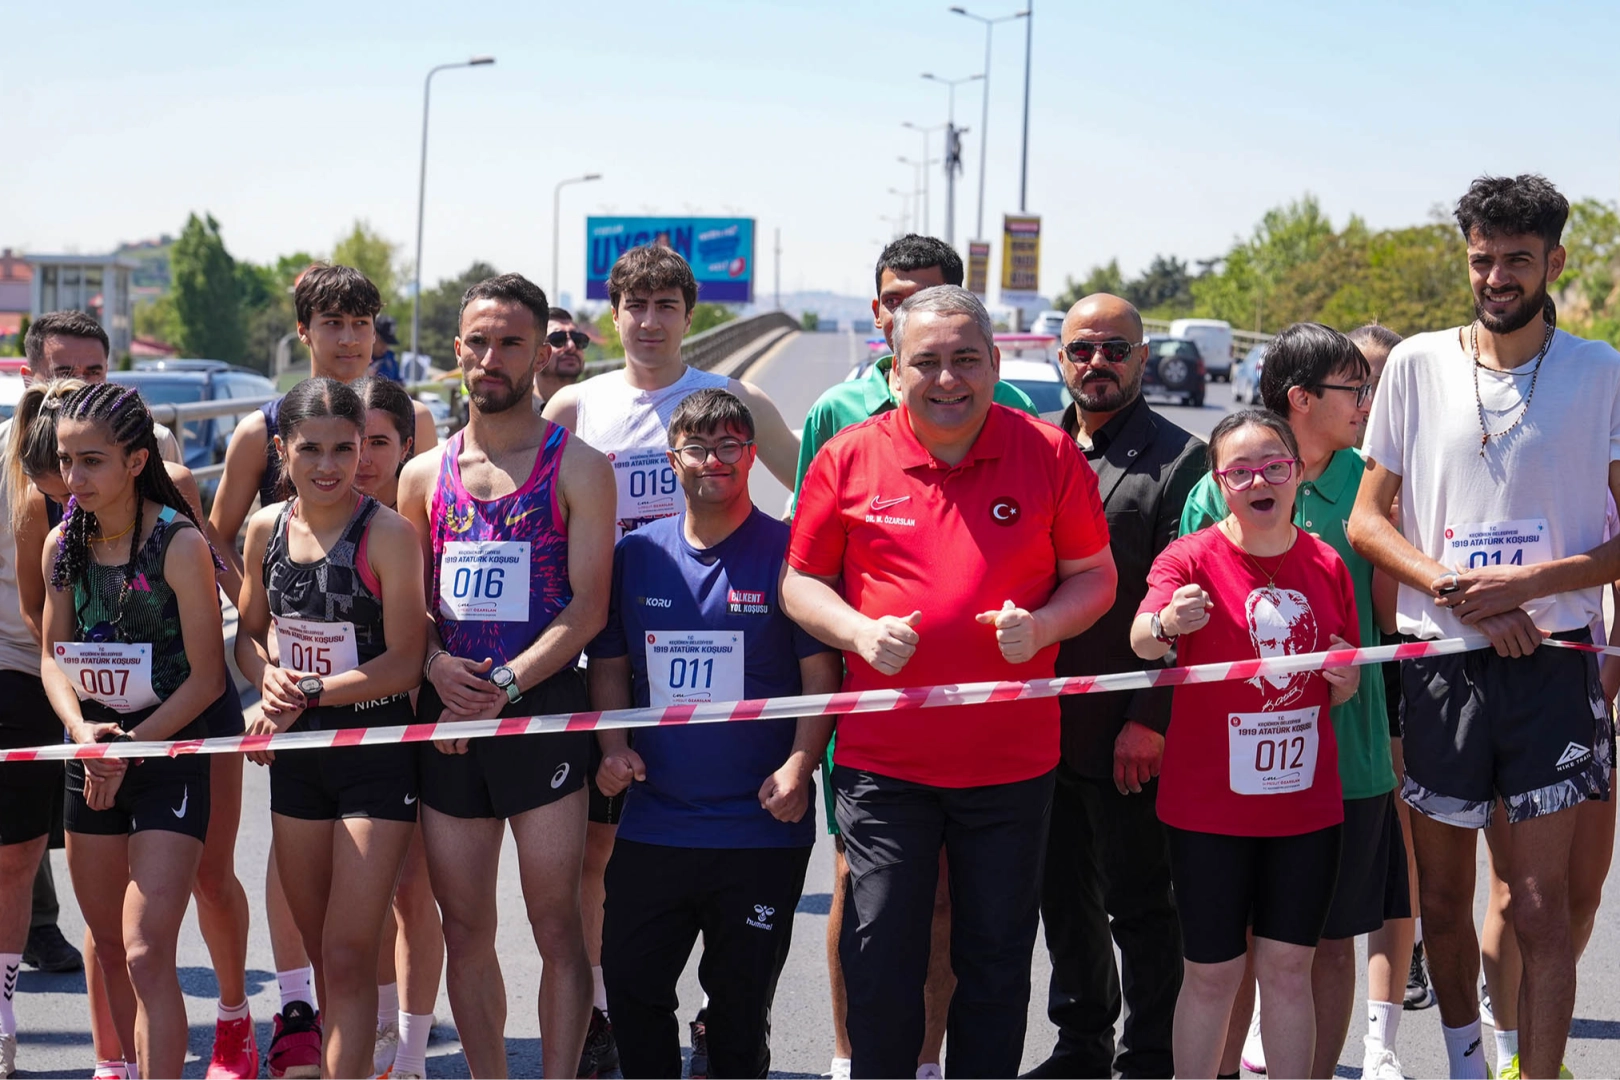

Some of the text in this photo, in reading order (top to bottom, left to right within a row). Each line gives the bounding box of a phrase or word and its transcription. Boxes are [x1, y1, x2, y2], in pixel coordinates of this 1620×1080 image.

[594, 226, 692, 275] UYN
[630, 458, 659, 467] ATATÜRK
[630, 467, 676, 498] 019
[884, 514, 916, 526] ÖZARSLAN
[1452, 535, 1540, 548] 1919 ATATÜRK KOŞUSU
[488, 556, 520, 564] KOŞUSU
[453, 568, 505, 598] 016
[646, 597, 672, 608] KORU
[731, 591, 762, 604] BİLKENT
[730, 603, 768, 614] YOL KOŞUSU
[292, 631, 314, 642] ATATÜRK
[314, 636, 344, 644] KOŞUSU
[670, 645, 700, 654] ATATÜRK
[702, 646, 732, 654] KOŞUSU
[80, 656, 110, 664] ATATÜRK
[112, 658, 141, 666] KOŞUSU
[292, 642, 332, 676] 015
[670, 658, 714, 688] 011
[80, 668, 130, 696] 007
[1258, 726, 1291, 736] ATATÜRK
[1292, 722, 1312, 732] KOŞUSU
[1255, 736, 1304, 772] 012
[1556, 762, 1574, 772] NIKE
[746, 916, 773, 930] hummel
